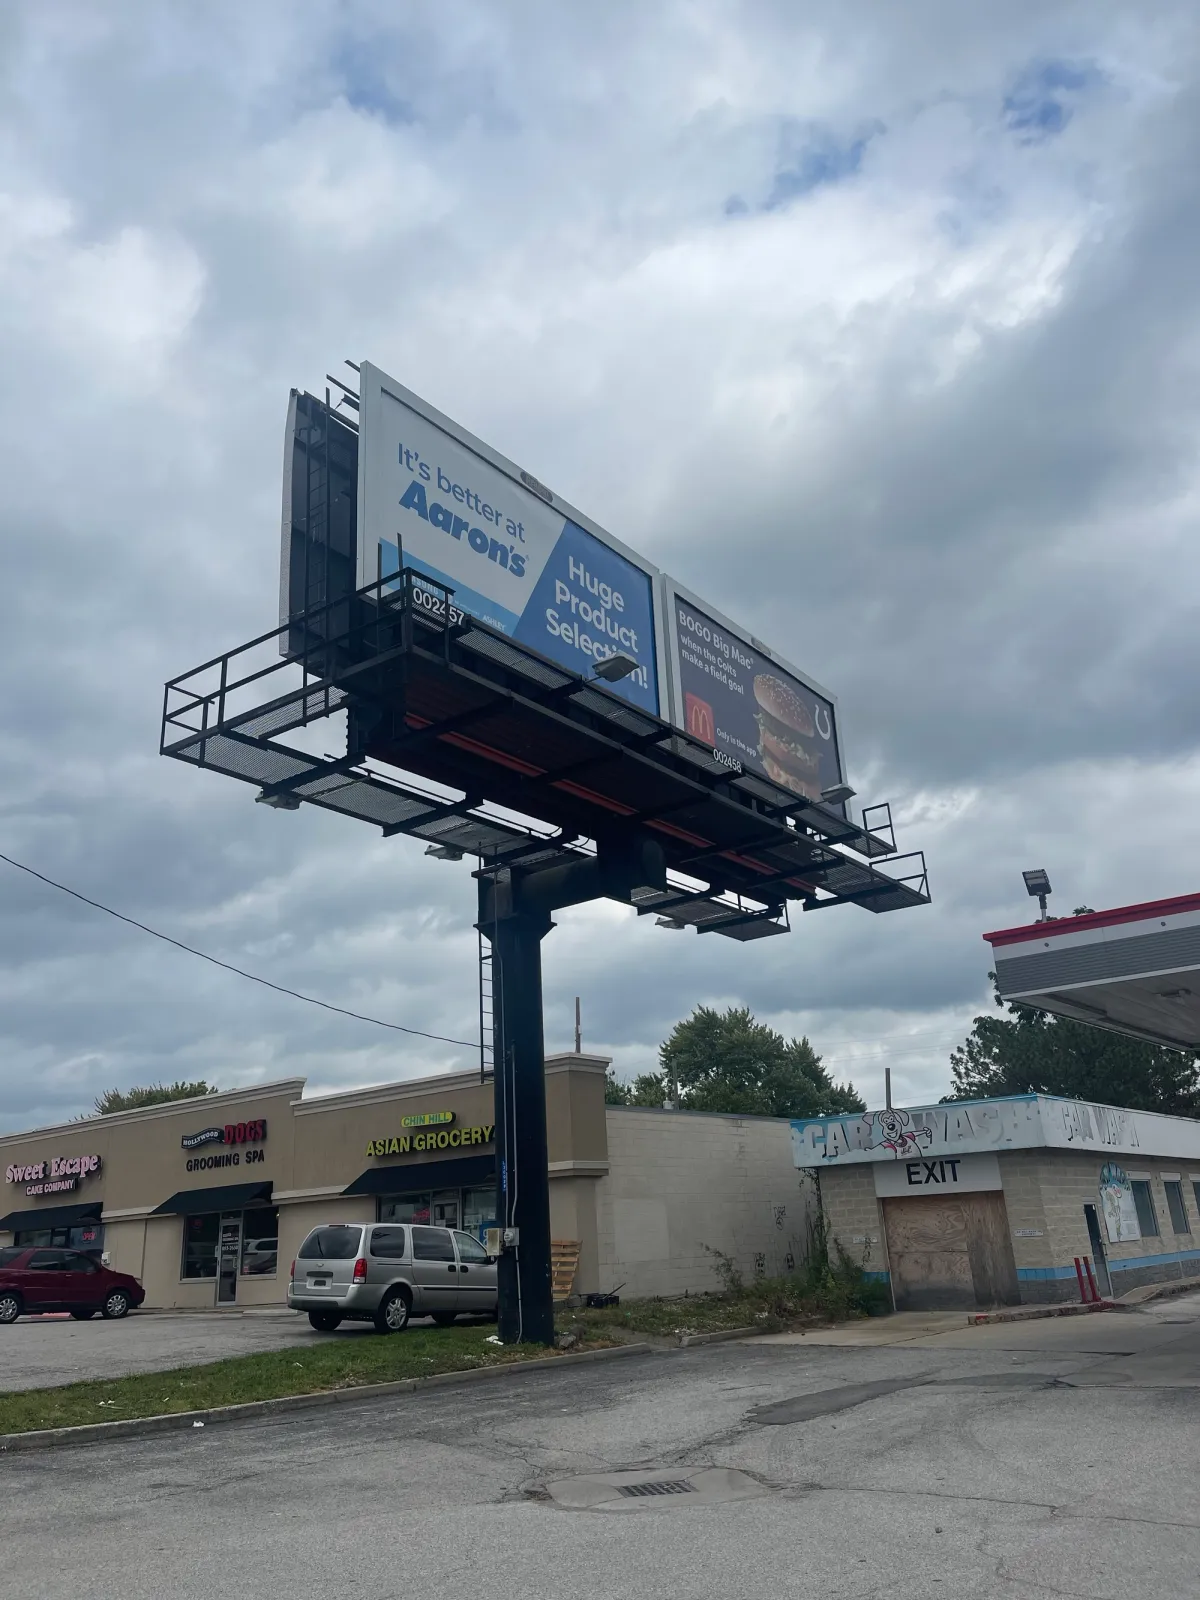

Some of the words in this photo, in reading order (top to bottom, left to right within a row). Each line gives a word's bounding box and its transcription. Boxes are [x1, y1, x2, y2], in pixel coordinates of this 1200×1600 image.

[399, 442, 431, 482] It's
[437, 466, 503, 527] better
[506, 514, 526, 543] at
[398, 480, 526, 578] Aaron's
[568, 555, 625, 612] Huge
[412, 587, 465, 625] 002457
[555, 579, 638, 653] Product
[679, 610, 711, 643] BOGO
[713, 632, 730, 658] Big
[731, 645, 751, 670] Mac
[681, 634, 702, 655] when
[703, 648, 717, 664] the
[717, 656, 737, 677] Colts
[682, 649, 703, 669] make
[704, 664, 710, 673] a
[710, 666, 727, 685] field
[728, 680, 744, 695] goal
[716, 727, 730, 744] Only
[730, 735, 736, 745] in
[736, 739, 746, 751] the
[746, 745, 757, 757] app
[713, 749, 742, 773] 002458
[183, 1131, 219, 1146] HOLLYWOOD
[224, 1119, 265, 1145] DOGS
[404, 1116, 426, 1126] CHIN
[428, 1112, 449, 1123] HILL
[366, 1136, 410, 1156] ASIAN
[414, 1125, 493, 1150] GROCERY
[5, 1164, 45, 1184] Sweet
[50, 1155, 98, 1178] Escape
[186, 1153, 240, 1172] GROOMING
[245, 1149, 265, 1164] SPA
[905, 1159, 961, 1185] EXIT
[26, 1184, 43, 1195] CAKE
[44, 1179, 74, 1193] COMPANY
